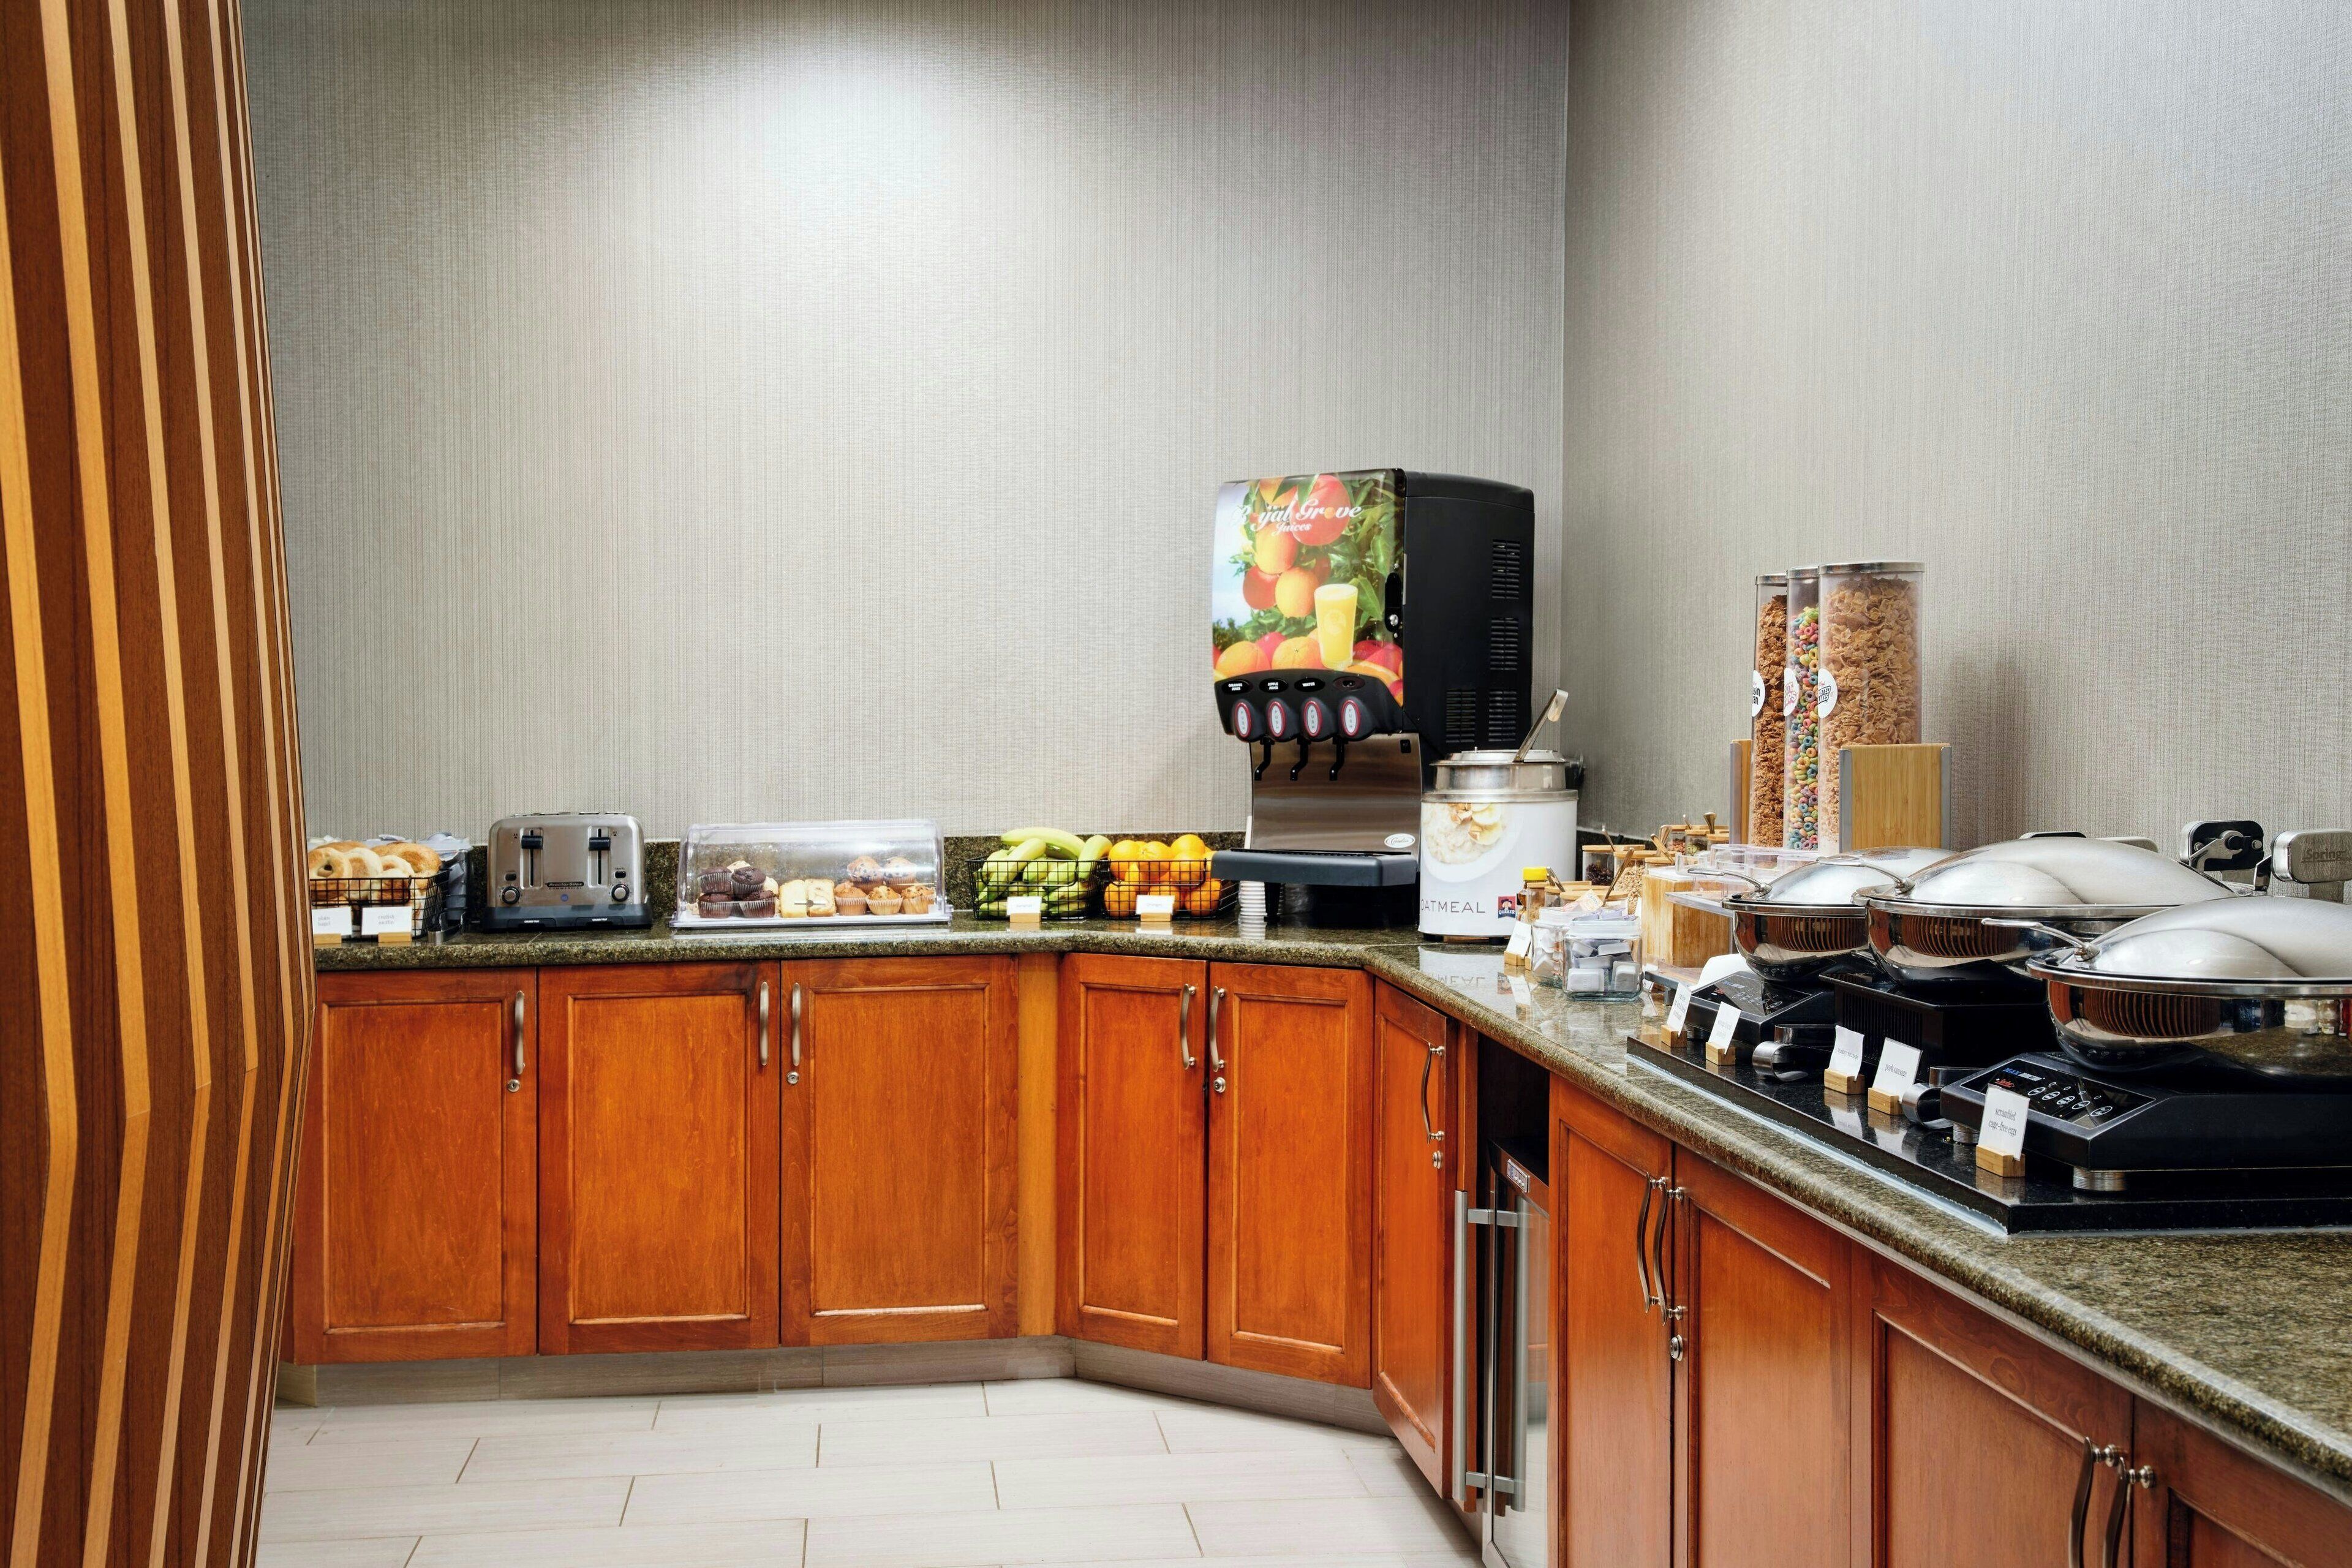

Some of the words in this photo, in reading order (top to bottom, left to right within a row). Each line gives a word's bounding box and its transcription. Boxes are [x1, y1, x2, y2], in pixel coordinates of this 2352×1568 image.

[1295, 499, 1363, 520] Grove
[1271, 522, 1312, 535] Juices
[1421, 899, 1486, 914] OATMEAL
[1885, 1063, 1894, 1072] pork
[1995, 1108, 2016, 1121] scrambled
[1988, 1120, 2008, 1133] cage-free
[2008, 1127, 2017, 1137] eggs
